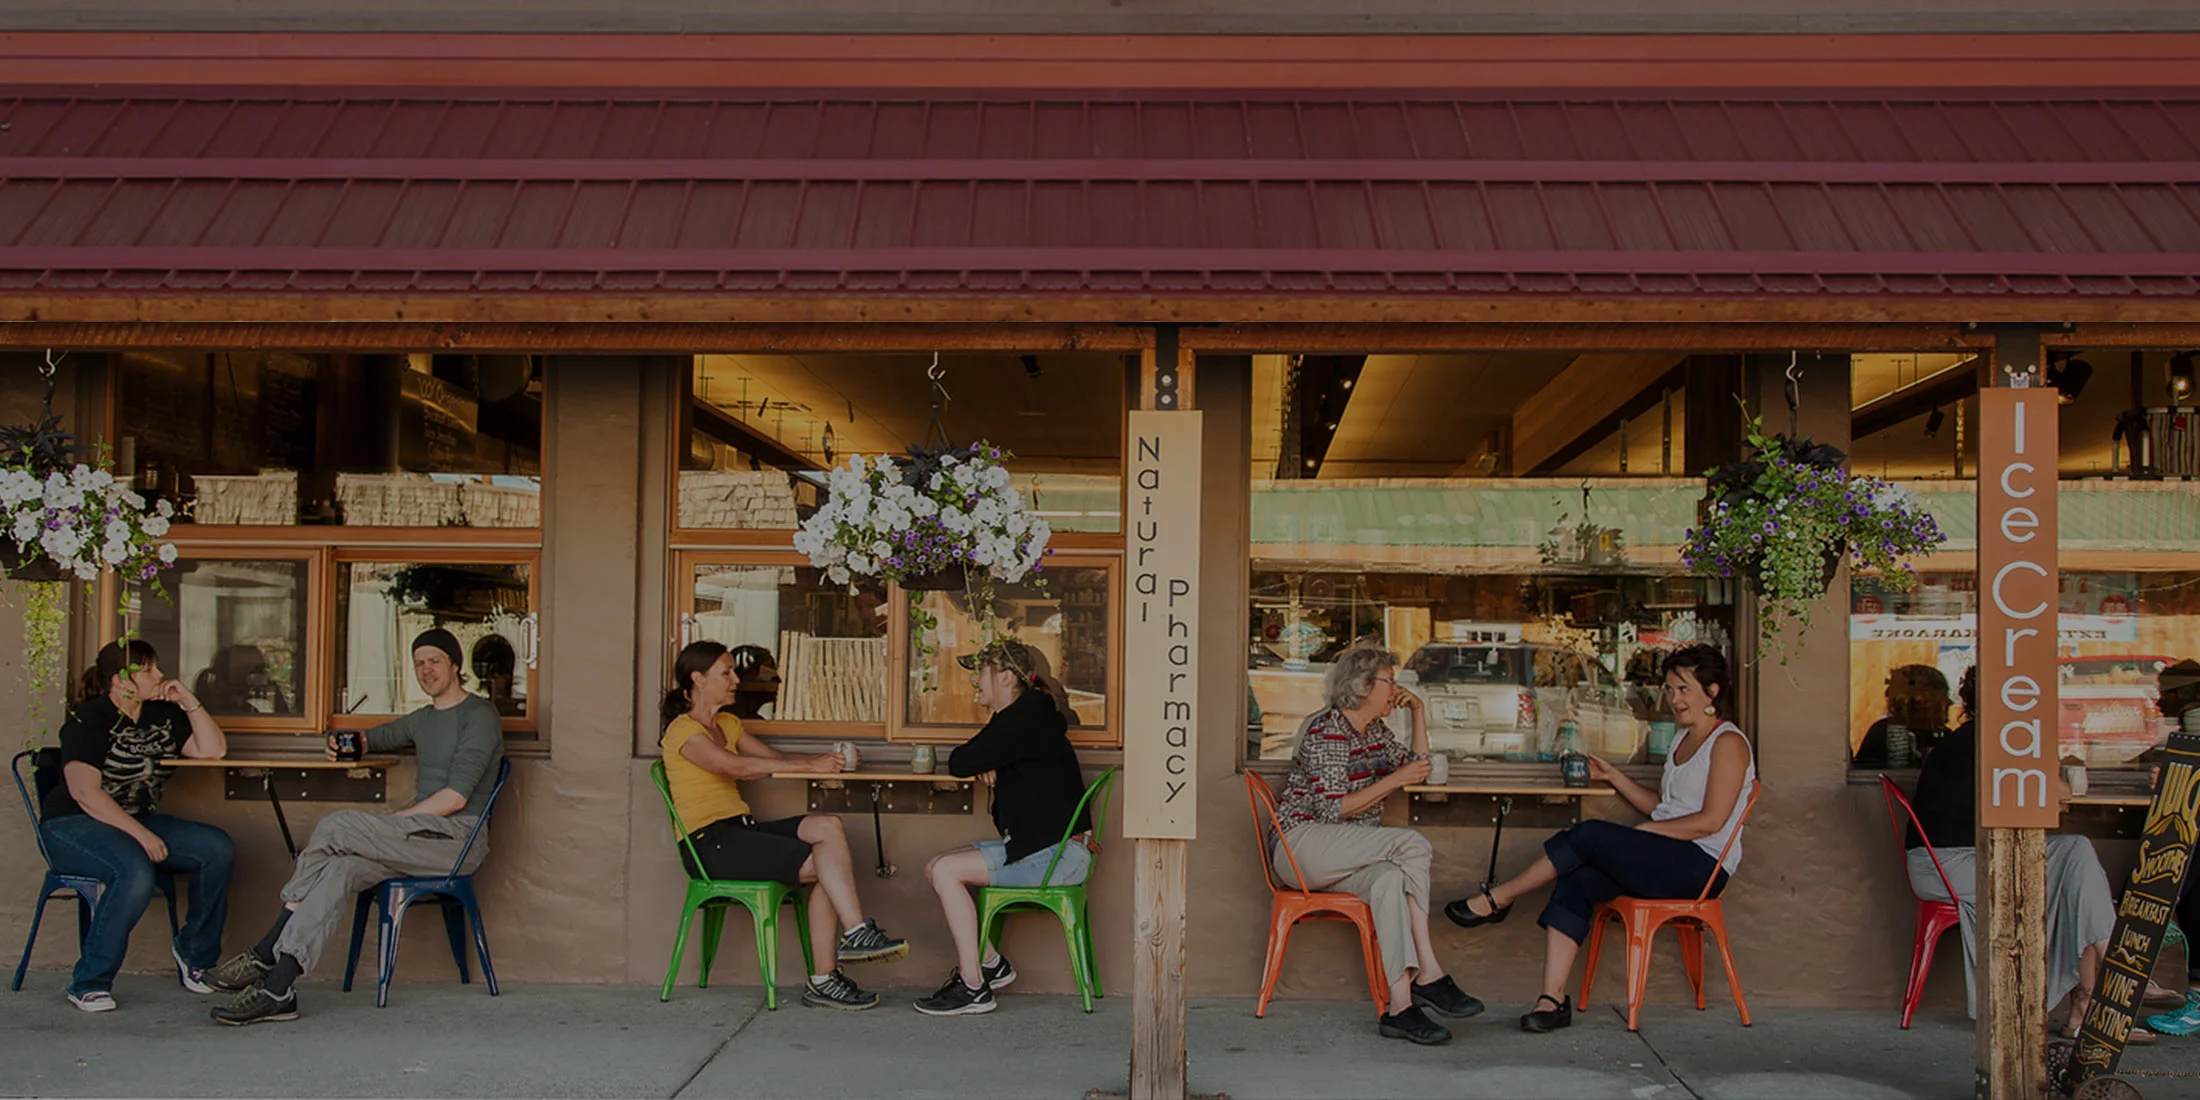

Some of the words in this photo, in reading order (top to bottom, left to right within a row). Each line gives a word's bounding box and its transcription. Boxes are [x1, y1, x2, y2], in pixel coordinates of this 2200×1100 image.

[2000, 402, 2040, 543] Ice
[1135, 436, 1160, 622] Natural
[1164, 579, 1190, 803] Pharmacy
[1992, 560, 2049, 808] Cream
[2112, 923, 2152, 960] LUNCH
[2118, 889, 2171, 926] BREAKFAST
[2084, 998, 2133, 1044] TASTING
[2101, 968, 2139, 1009] WINE
